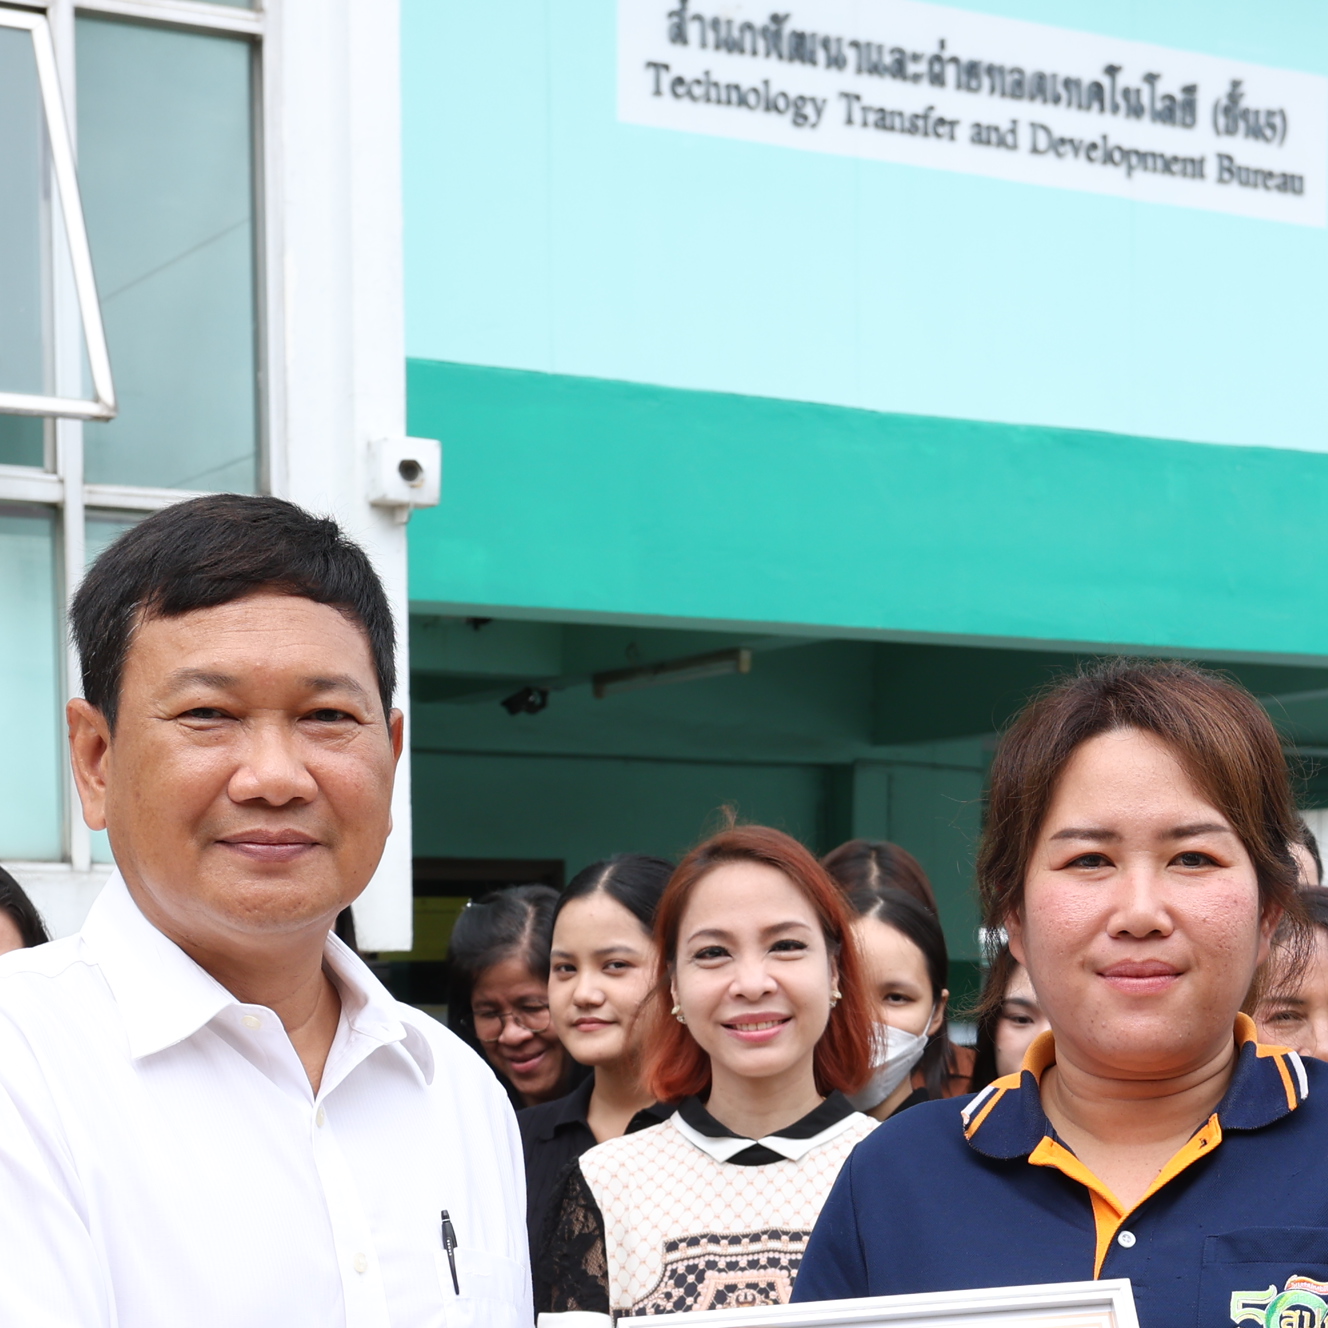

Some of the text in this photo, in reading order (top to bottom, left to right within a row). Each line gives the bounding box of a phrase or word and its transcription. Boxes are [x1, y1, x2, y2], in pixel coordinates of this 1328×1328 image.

[645, 61, 1305, 197] Technology Transfer and Development Bureau
